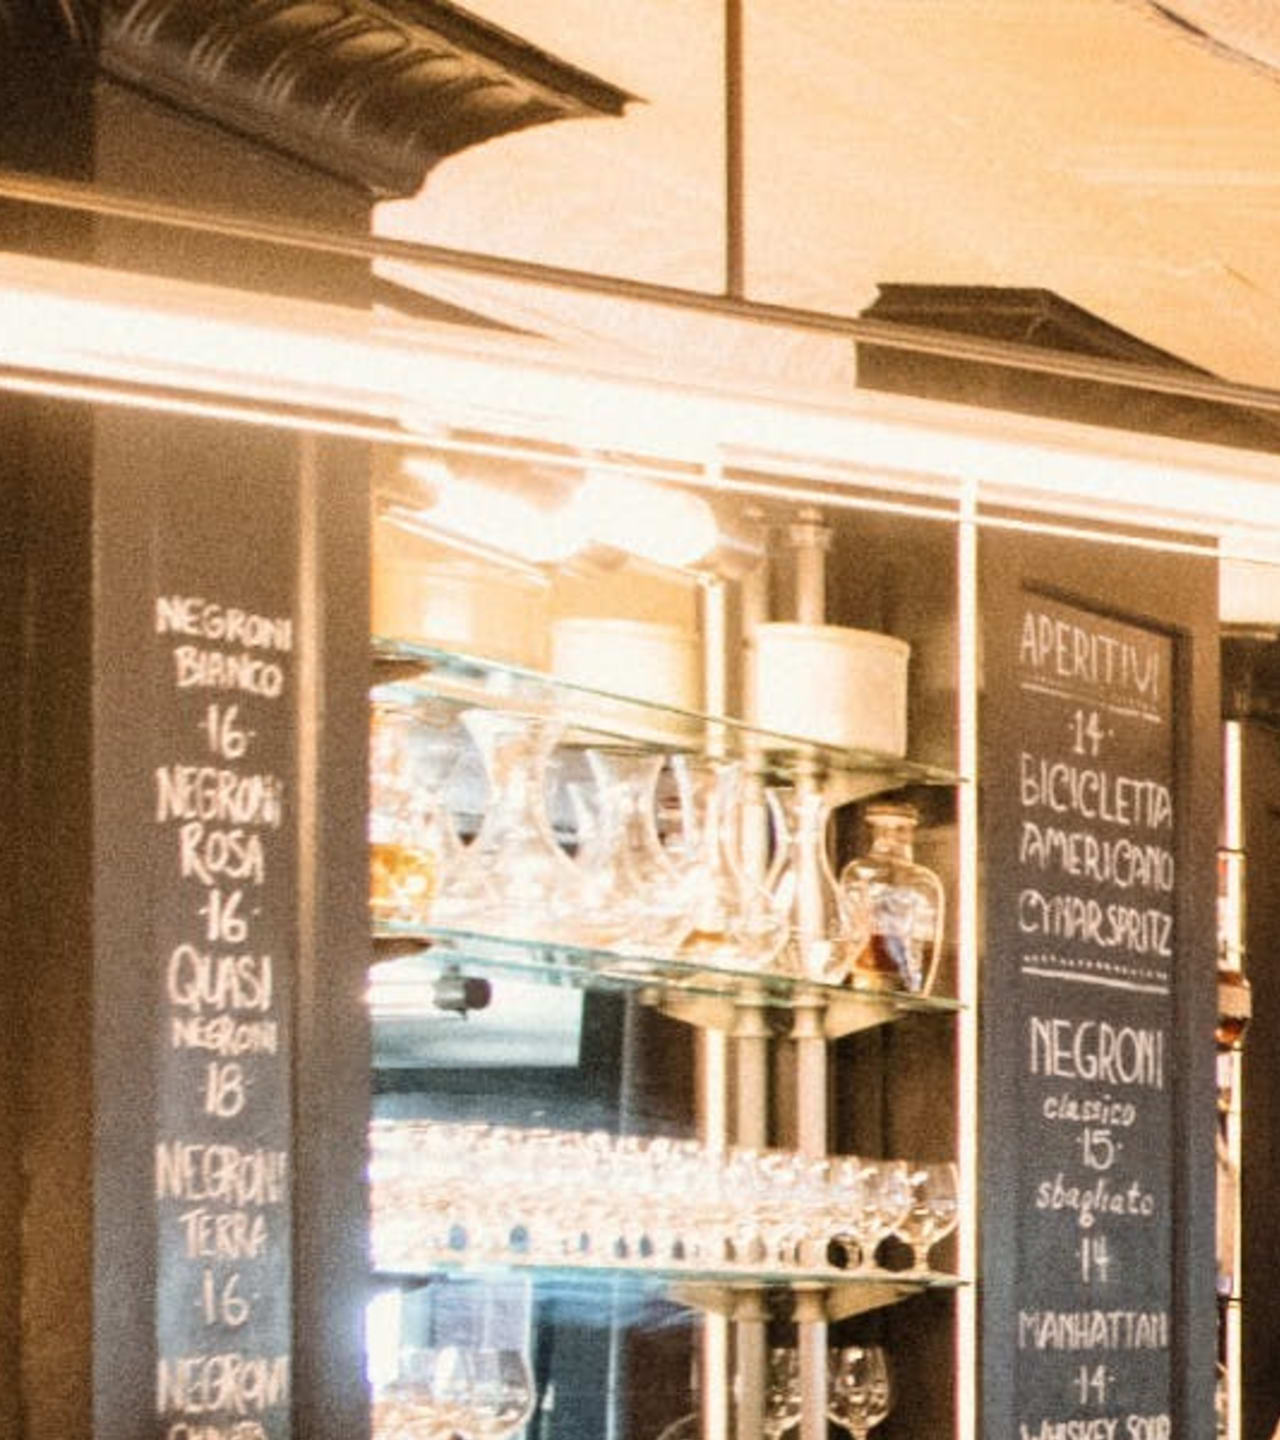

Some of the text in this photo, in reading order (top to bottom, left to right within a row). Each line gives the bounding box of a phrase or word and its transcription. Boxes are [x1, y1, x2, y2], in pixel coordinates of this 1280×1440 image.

[156, 597, 292, 651] NEGRONI
[1020, 612, 1160, 697] APERITIVI
[174, 646, 284, 697] BIANCO
[156, 765, 283, 829] NEGRONI
[1020, 751, 1172, 828] BICICLETTA
[179, 821, 265, 886] ROSA
[1019, 821, 1174, 891] AMERICANO
[1106, 903, 1173, 957] SPRITZ
[167, 945, 272, 1012] QUASI
[171, 1014, 277, 1056] NEGRONI
[1029, 1017, 1163, 1090] NEGRONI
[156, 1140, 289, 1206] NEGRONI
[178, 1208, 268, 1260] TERRA
[1018, 1310, 1168, 1350] MANHATTAN
[157, 1353, 290, 1414] NEGRONI
